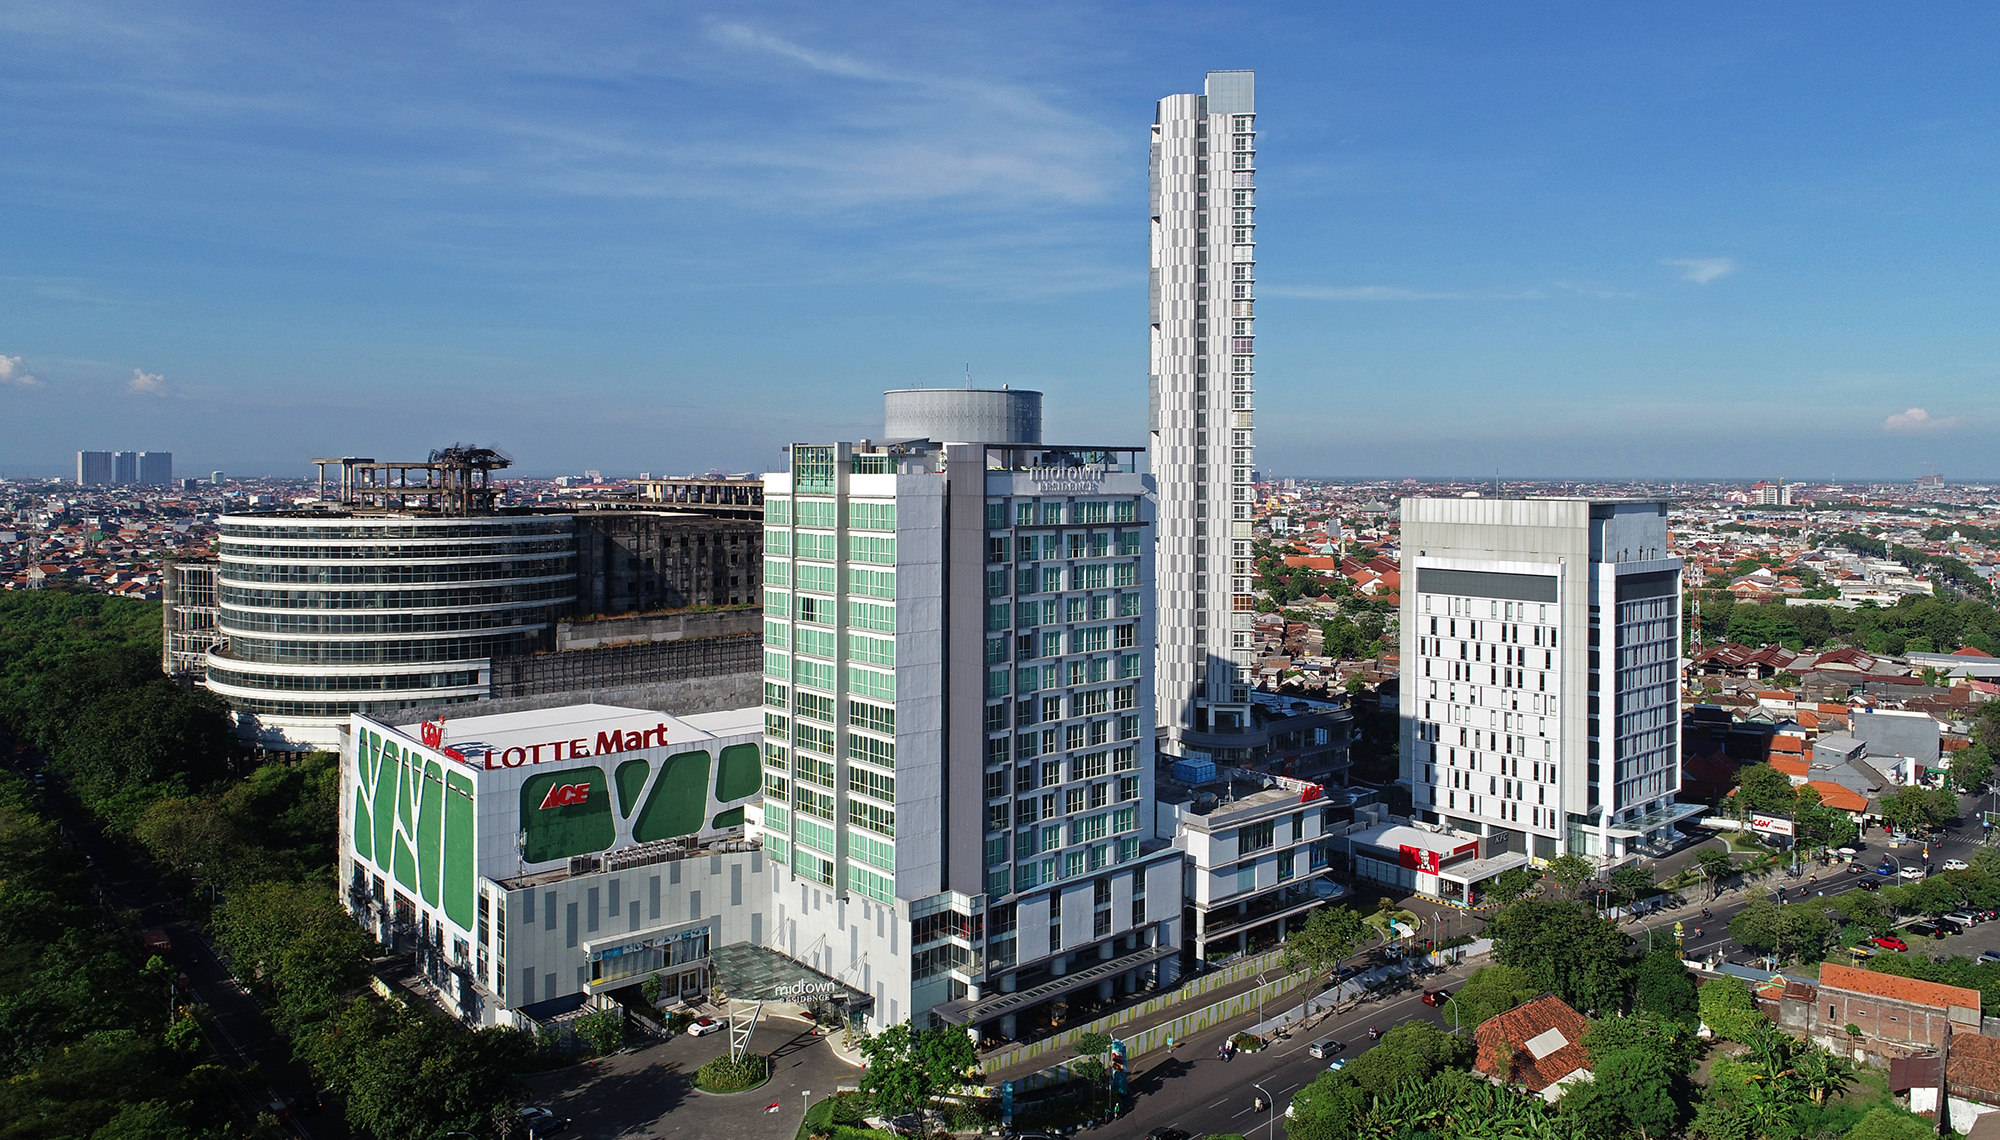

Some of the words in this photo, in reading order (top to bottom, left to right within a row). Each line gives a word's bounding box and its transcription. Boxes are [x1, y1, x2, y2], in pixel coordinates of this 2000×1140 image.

[1029, 458, 1101, 480] midtown
[1038, 481, 1095, 493] RESIDENCE
[421, 720, 442, 750] CGV
[484, 738, 588, 770] LOTTE
[594, 722, 668, 756] Mart
[538, 782, 590, 810] ACE
[1752, 819, 1770, 828] CGV
[1494, 832, 1508, 844] KFC
[775, 978, 835, 996] midtown
[780, 993, 831, 1004] RESIDENCE
